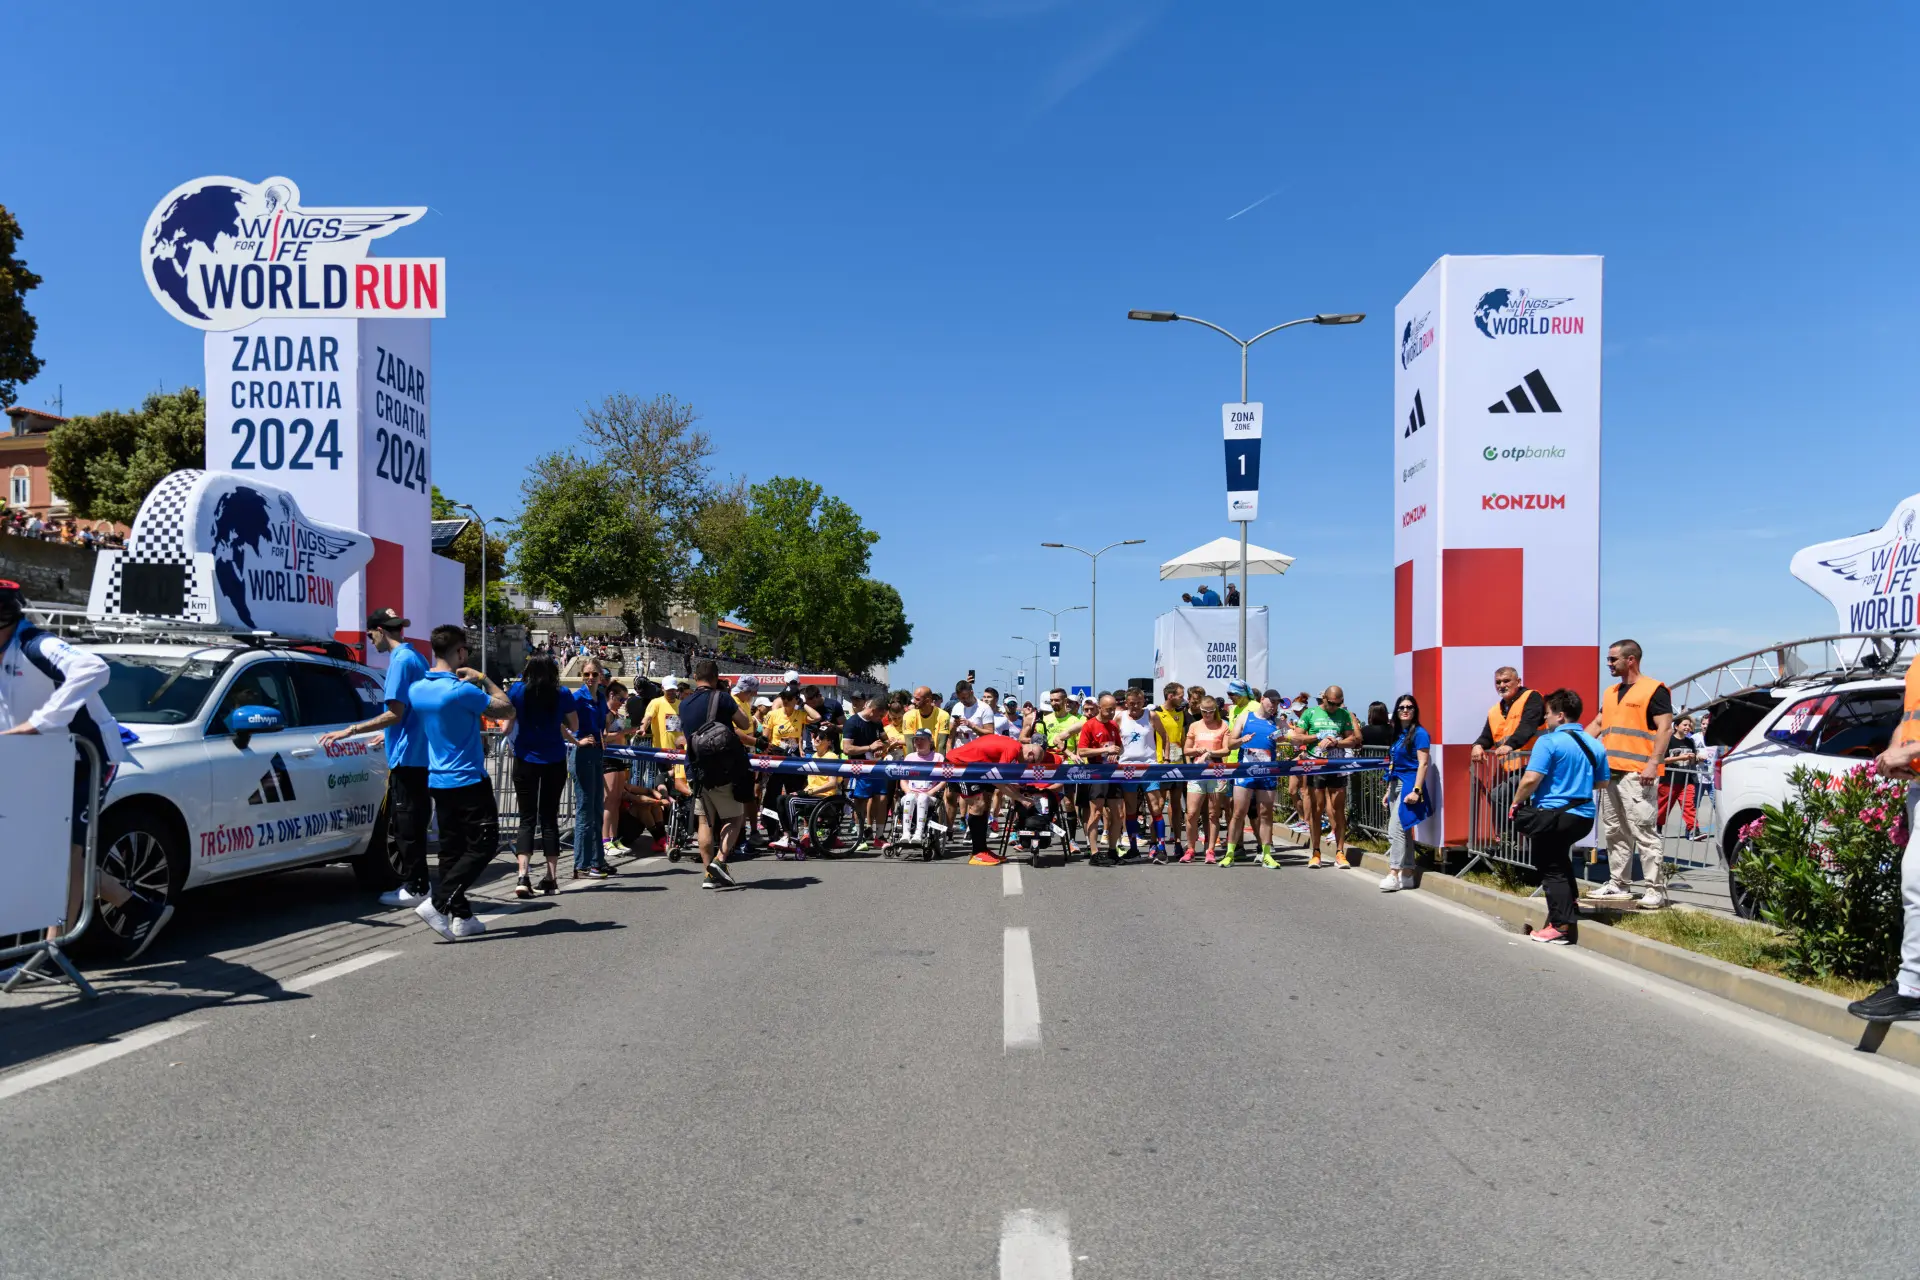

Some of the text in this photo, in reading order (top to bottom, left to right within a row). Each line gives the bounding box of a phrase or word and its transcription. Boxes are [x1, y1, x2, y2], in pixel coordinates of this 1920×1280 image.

[240, 212, 343, 240] WINGS
[233, 241, 313, 262] FOR LIFE
[1509, 298, 1549, 309] WINGS
[1513, 308, 1537, 318] LIFE
[231, 336, 340, 372] ZADAR
[376, 345, 425, 405] ZADAR
[231, 380, 342, 409] CROATIA
[376, 390, 427, 440] CROATIA
[1230, 411, 1255, 422] ZONA
[1234, 422, 1251, 431] ZONE
[230, 417, 343, 470] 2024
[376, 427, 427, 495] 2024
[1237, 454, 1246, 476] 1
[1481, 493, 1566, 510] KONZUM
[1402, 503, 1427, 528] KONZUM
[271, 521, 327, 555] WINGS
[271, 546, 315, 573] FOR LIFE
[1862, 567, 1918, 596] FOR LIFE
[191, 600, 207, 610] km
[1850, 594, 1914, 634] WORLD
[1052, 645, 1057, 653] 2
[1207, 642, 1237, 653] ZADAR
[1206, 654, 1238, 663] CROATIA
[757, 676, 784, 684] TISAK
[1206, 664, 1238, 679] 2024
[248, 714, 278, 726] allwyn
[324, 741, 368, 758] KONZUM
[200, 803, 375, 858] TRČIMO ZA ONE KOJI NE MOGU
